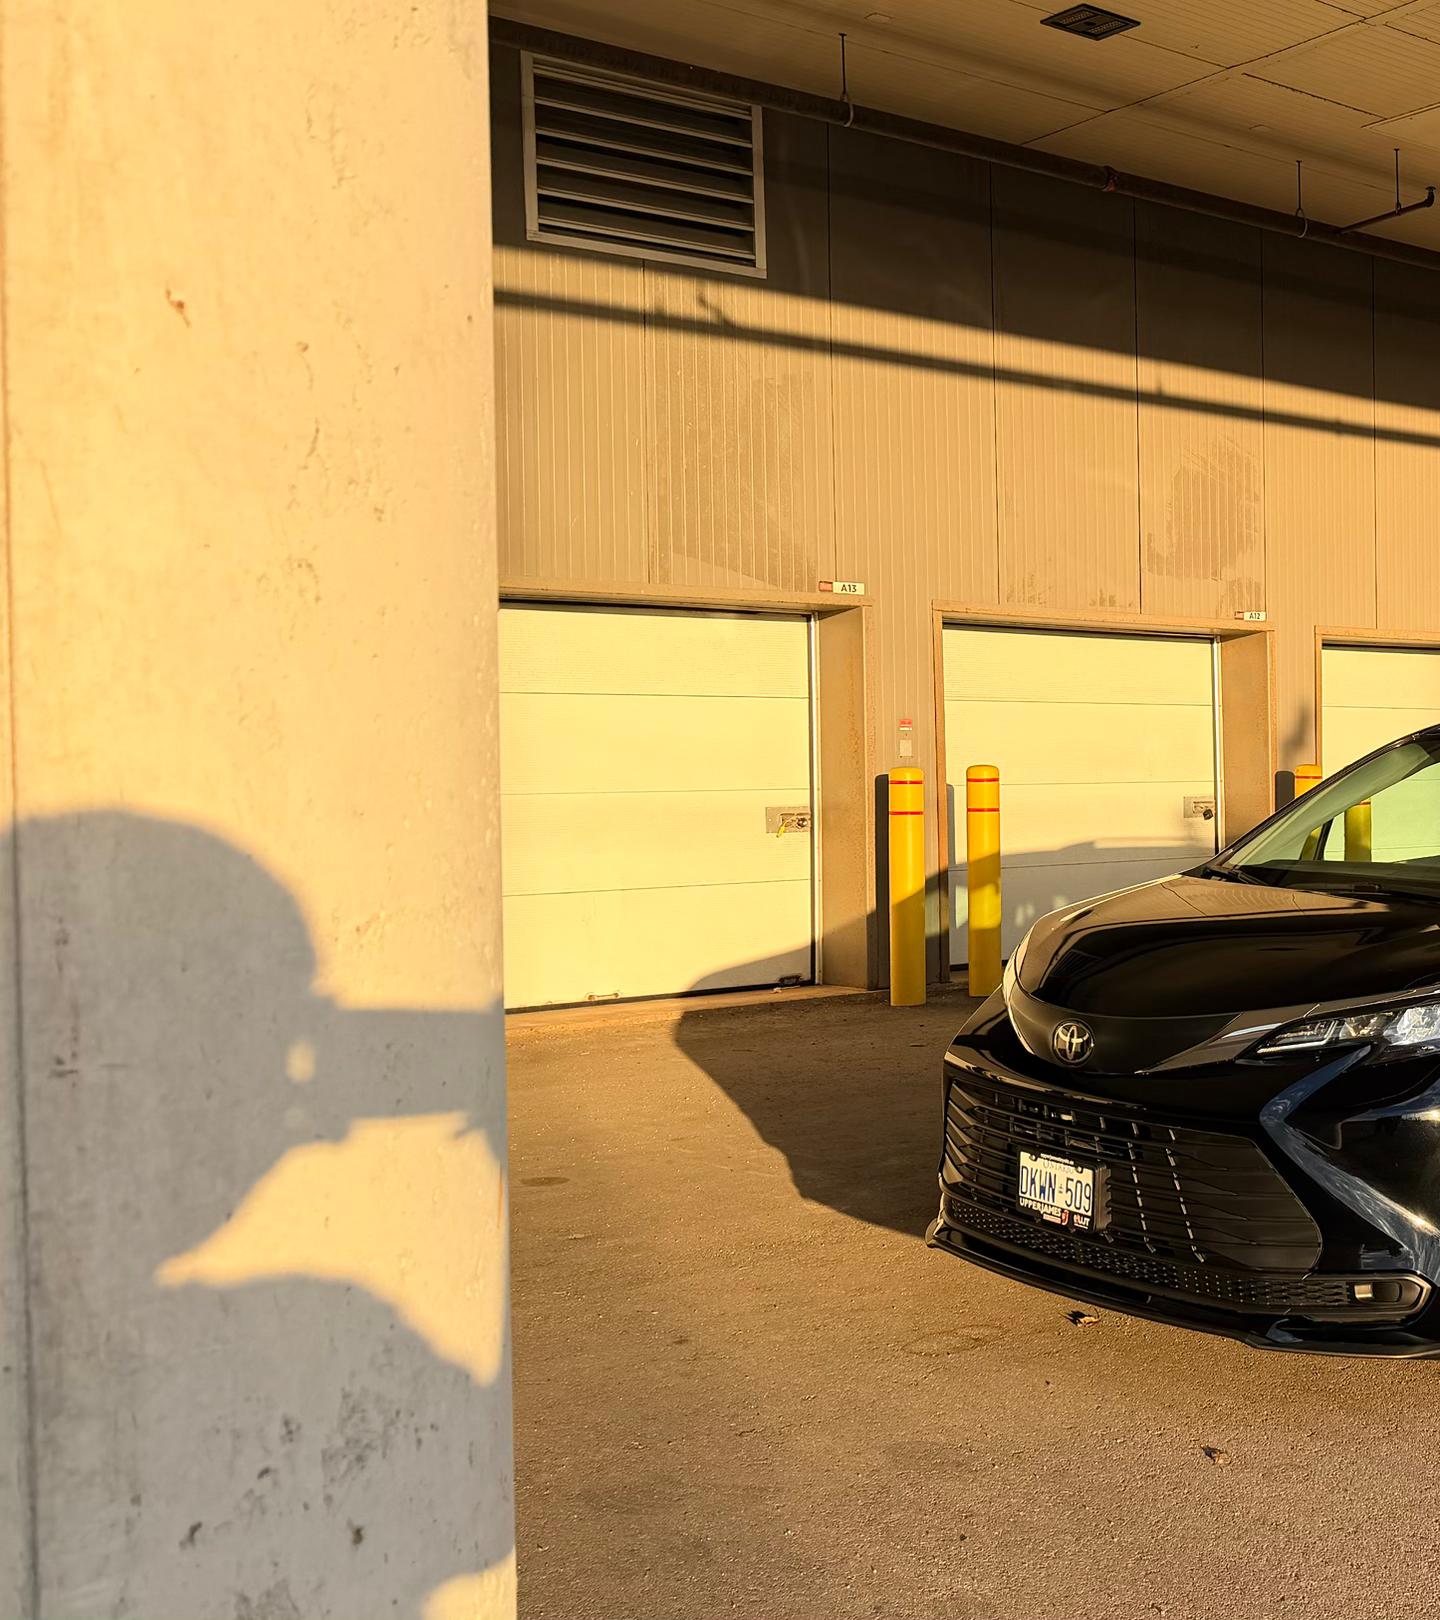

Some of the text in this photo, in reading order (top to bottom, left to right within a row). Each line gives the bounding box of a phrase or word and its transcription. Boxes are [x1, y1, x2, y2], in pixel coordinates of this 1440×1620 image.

[841, 584, 857, 593] A13
[1249, 612, 1261, 620] A12
[1020, 1165, 1092, 1213] DKWN 509
